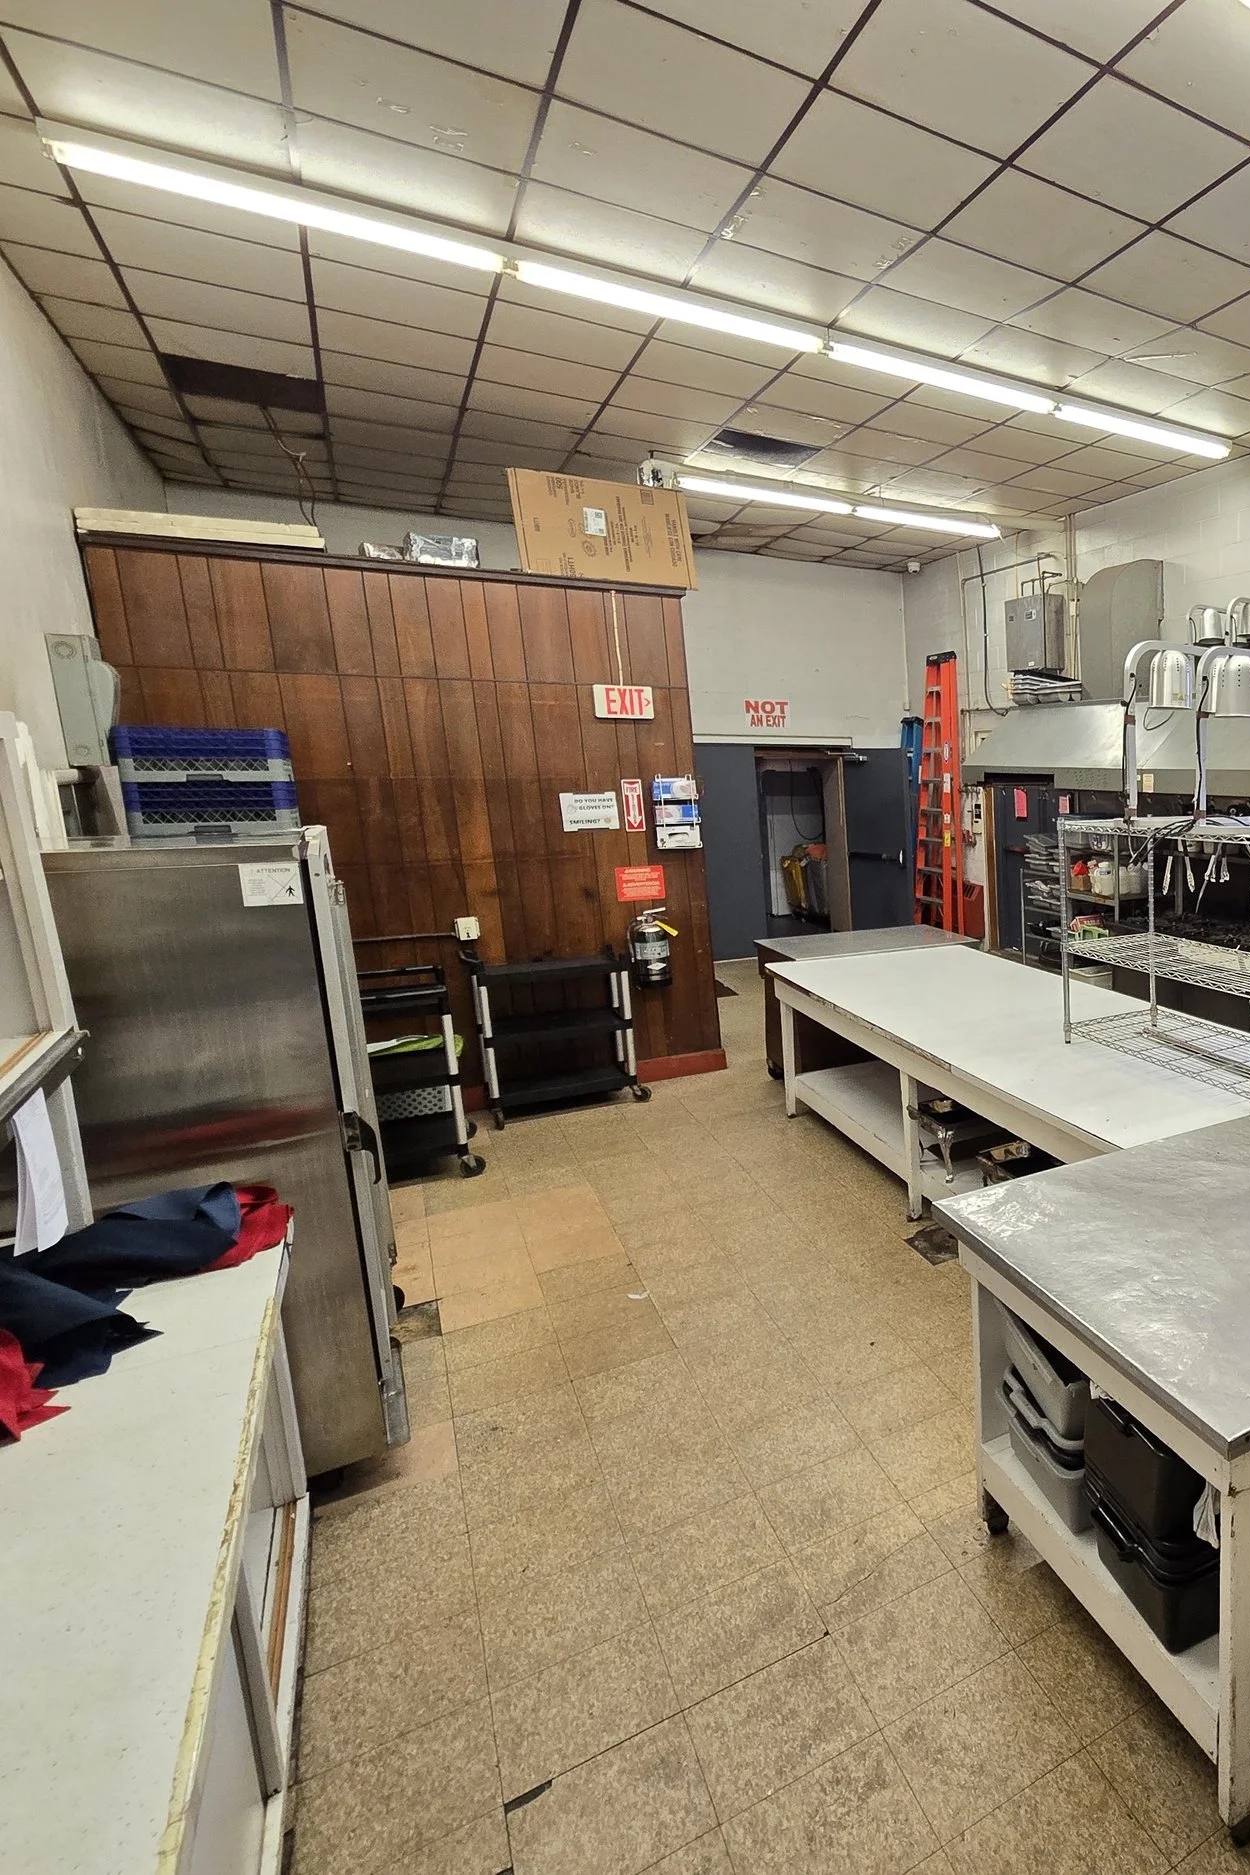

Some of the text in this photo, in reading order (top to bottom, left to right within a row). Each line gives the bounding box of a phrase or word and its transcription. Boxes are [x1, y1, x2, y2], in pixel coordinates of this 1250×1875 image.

[605, 687, 644, 715] EXIT
[745, 700, 788, 715] NOT
[750, 714, 786, 728] AN EXIT
